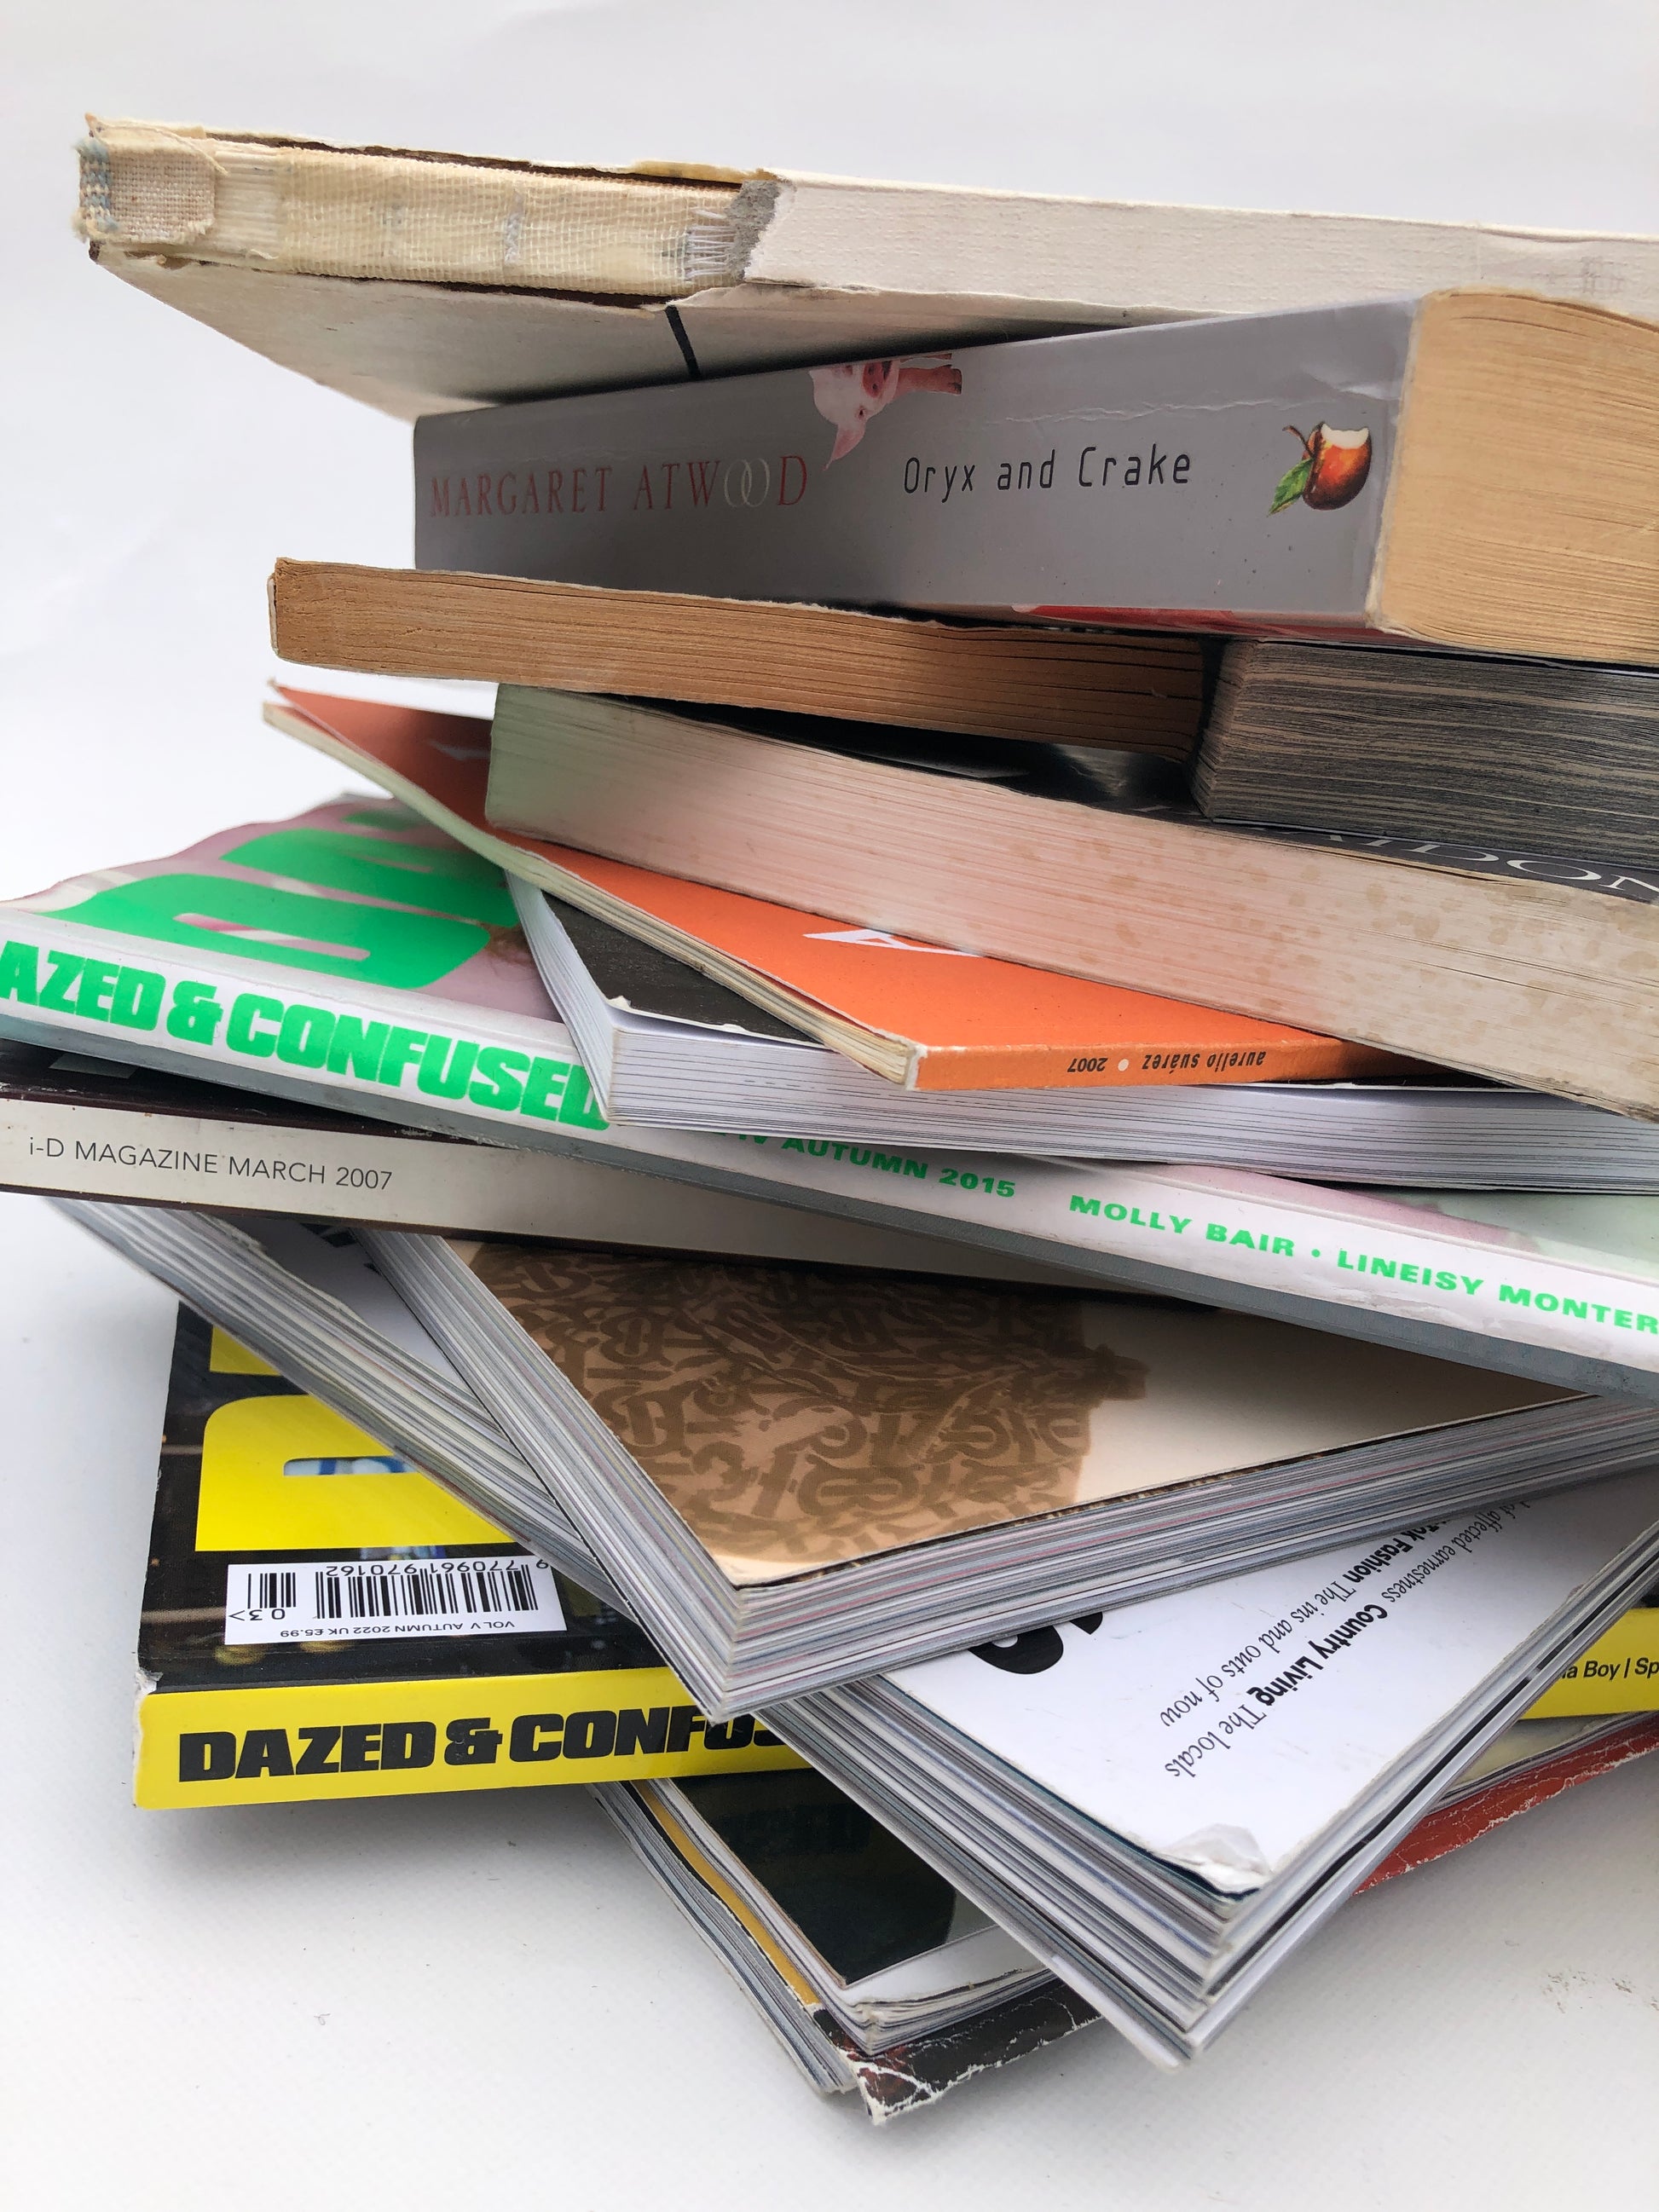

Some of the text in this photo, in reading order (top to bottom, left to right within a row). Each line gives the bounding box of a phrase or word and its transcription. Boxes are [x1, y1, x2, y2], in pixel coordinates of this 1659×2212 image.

[431, 455, 807, 517] MARGARET ATWOOD
[904, 443, 1191, 503] Oryx and Crake
[166, 979, 223, 1046] &
[1066, 1051, 1267, 1075] aurelio suárez 2007
[28, 1137, 393, 1191] i-D MAGAZINE MARCH 2007
[781, 1136, 928, 1180] AUTUMN
[938, 1168, 1016, 1198] 2015
[1068, 1194, 1193, 1234] MOLLY
[1205, 1222, 1295, 1257] BAIR
[1336, 1247, 1484, 1296] LINEISY
[1451, 1510, 1502, 1553] affected
[1343, 1537, 1413, 1584] Fashion
[1381, 1545, 1456, 1603] earnestness
[1315, 1580, 1357, 1606] The
[353, 1626, 390, 1634] 2022
[395, 1622, 464, 1633] AUTUMN
[488, 1620, 515, 1629] VOL
[1291, 1601, 1325, 1623] ins
[280, 1628, 325, 1637] £5.99
[1258, 1620, 1292, 1654] and
[1308, 1603, 1388, 1660] Country
[1222, 1645, 1261, 1678] outs
[1583, 1660, 1621, 1681] Boy
[1195, 1675, 1223, 1702] of
[1246, 1655, 1324, 1706] Living
[1160, 1691, 1202, 1727] now
[1219, 1704, 1267, 1734] The
[178, 1721, 436, 1782] DAZED
[443, 1717, 503, 1767] &
[1165, 1731, 1231, 1777] locals
